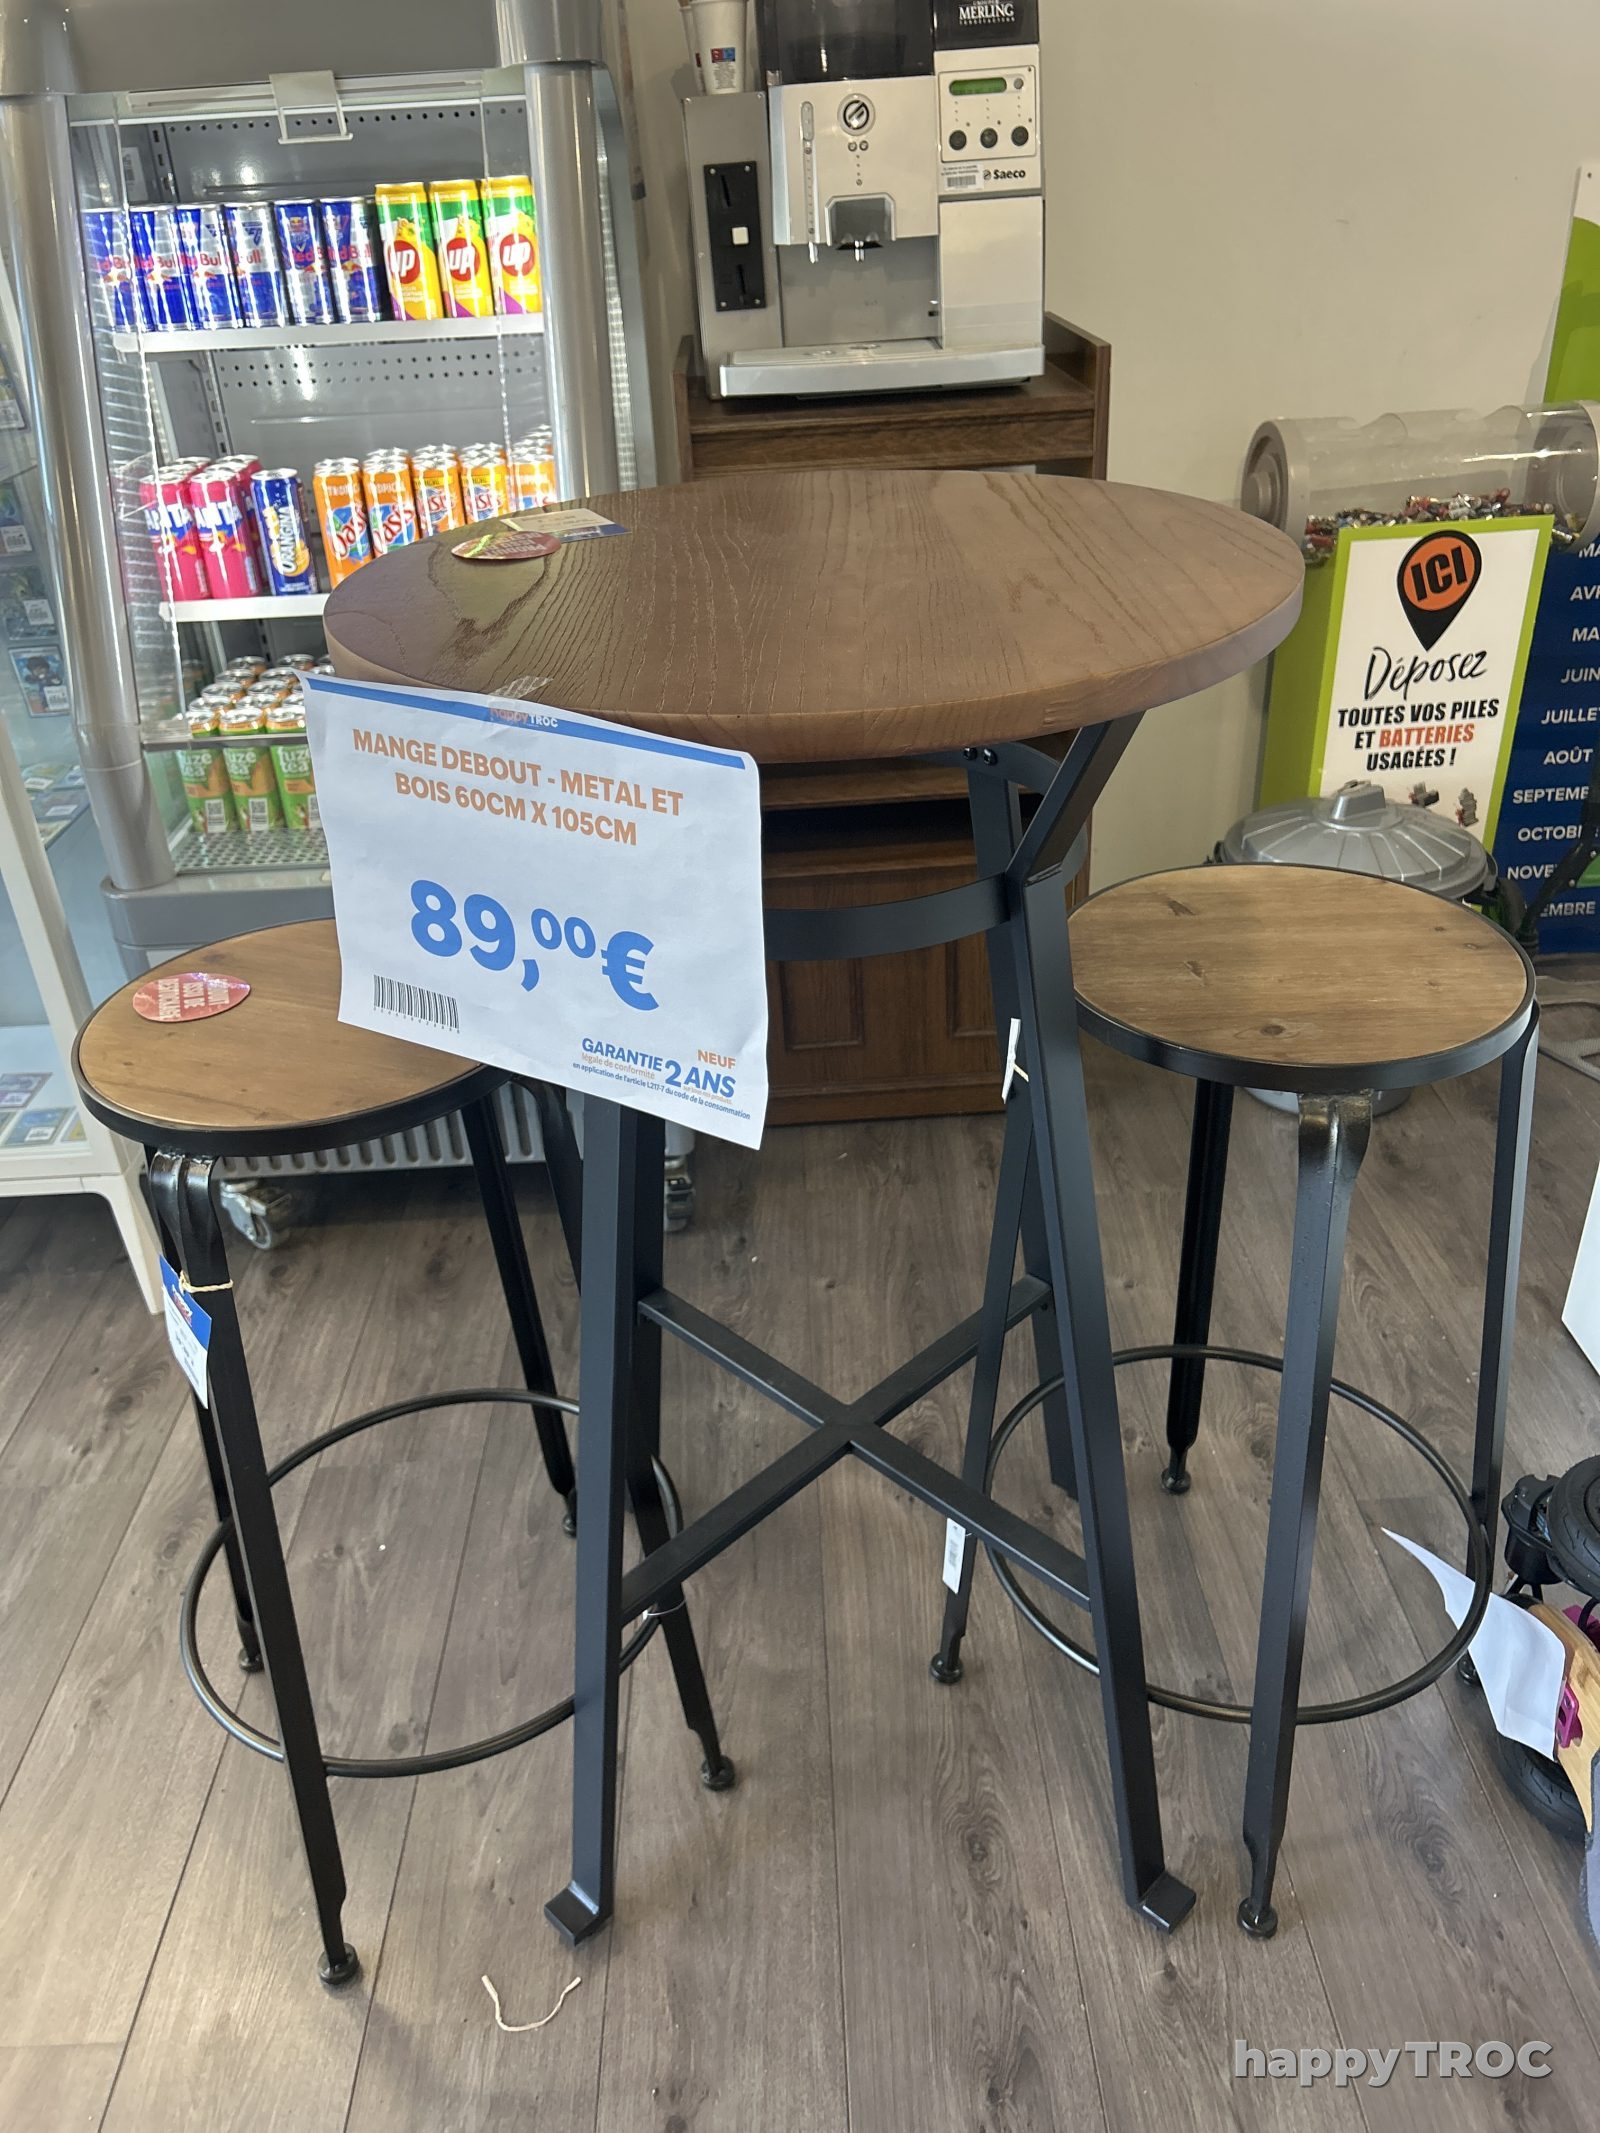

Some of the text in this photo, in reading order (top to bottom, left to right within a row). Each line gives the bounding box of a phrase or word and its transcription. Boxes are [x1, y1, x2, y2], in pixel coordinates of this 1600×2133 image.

[959, 3, 1015, 20] MERLING
[993, 169, 1026, 180] Saeco
[278, 506, 297, 572] ORANGINA
[1410, 546, 1468, 601] ICI
[1364, 646, 1488, 700] Déposez
[1338, 698, 1500, 728] TOUTES VOS PILES
[1354, 723, 1476, 750] ET BATTERIES
[1366, 746, 1446, 772] USAGÉES
[1543, 746, 1593, 765] AOÛT
[353, 728, 437, 767] MANGE
[441, 746, 541, 787] DEBOUT
[560, 769, 647, 810] METAL
[652, 787, 684, 817] ET
[395, 772, 637, 846] BOIS 60CM X 105CM
[582, 1037, 736, 1098] GARANTIE 2 ANS
[614, 1063, 656, 1080] conformité
[698, 1050, 736, 1070] NEUF
[581, 1064, 614, 1079] application
[615, 1073, 623, 1081] de
[665, 1087, 673, 1095] du
[674, 1090, 690, 1101] code
[690, 1095, 698, 1104] de
[704, 1100, 751, 1120] consommation
